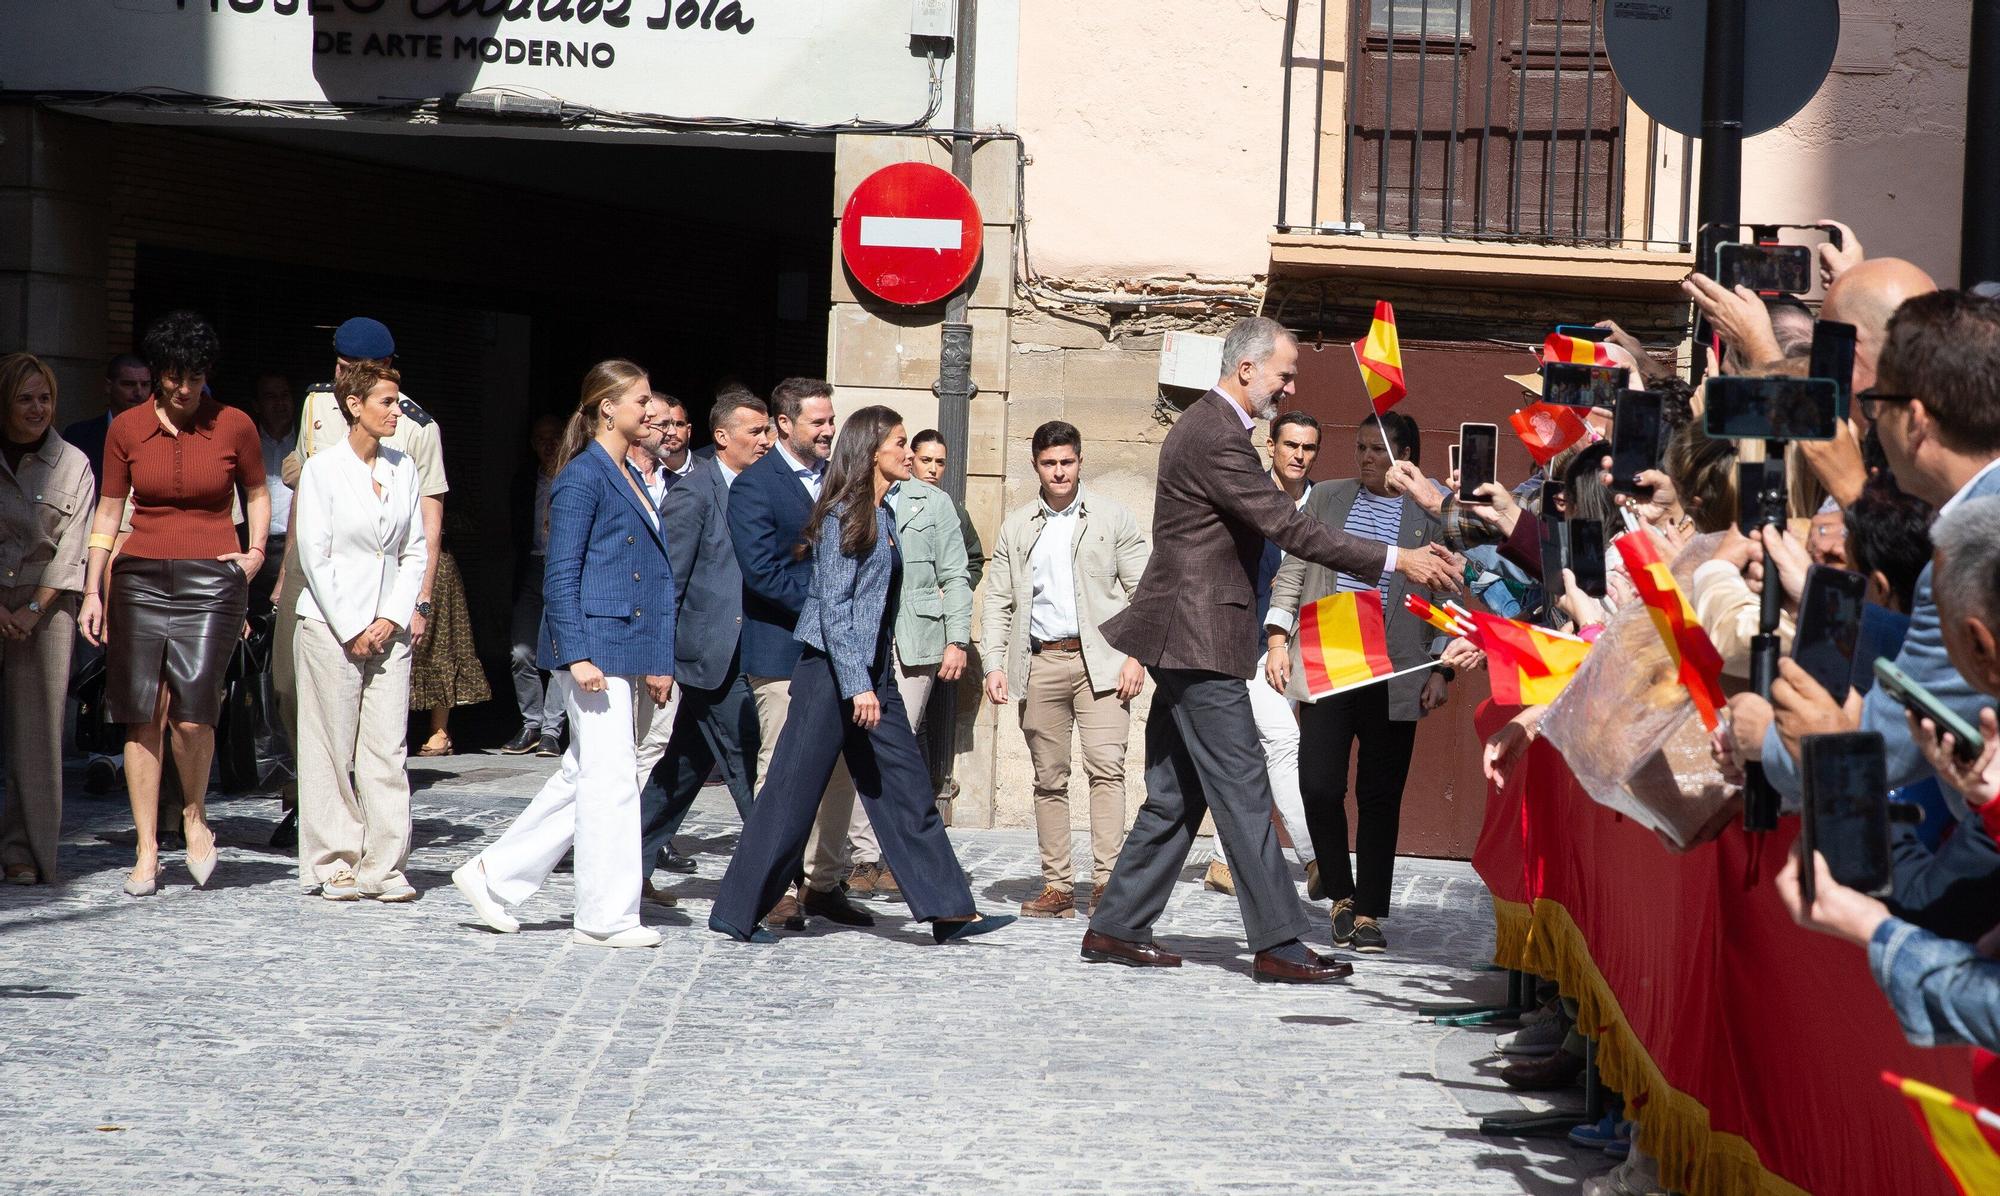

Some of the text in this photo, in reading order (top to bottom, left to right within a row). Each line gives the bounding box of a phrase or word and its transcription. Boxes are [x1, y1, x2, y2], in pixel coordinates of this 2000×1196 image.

[313, 32, 616, 69] DE ARTE MODERNO
